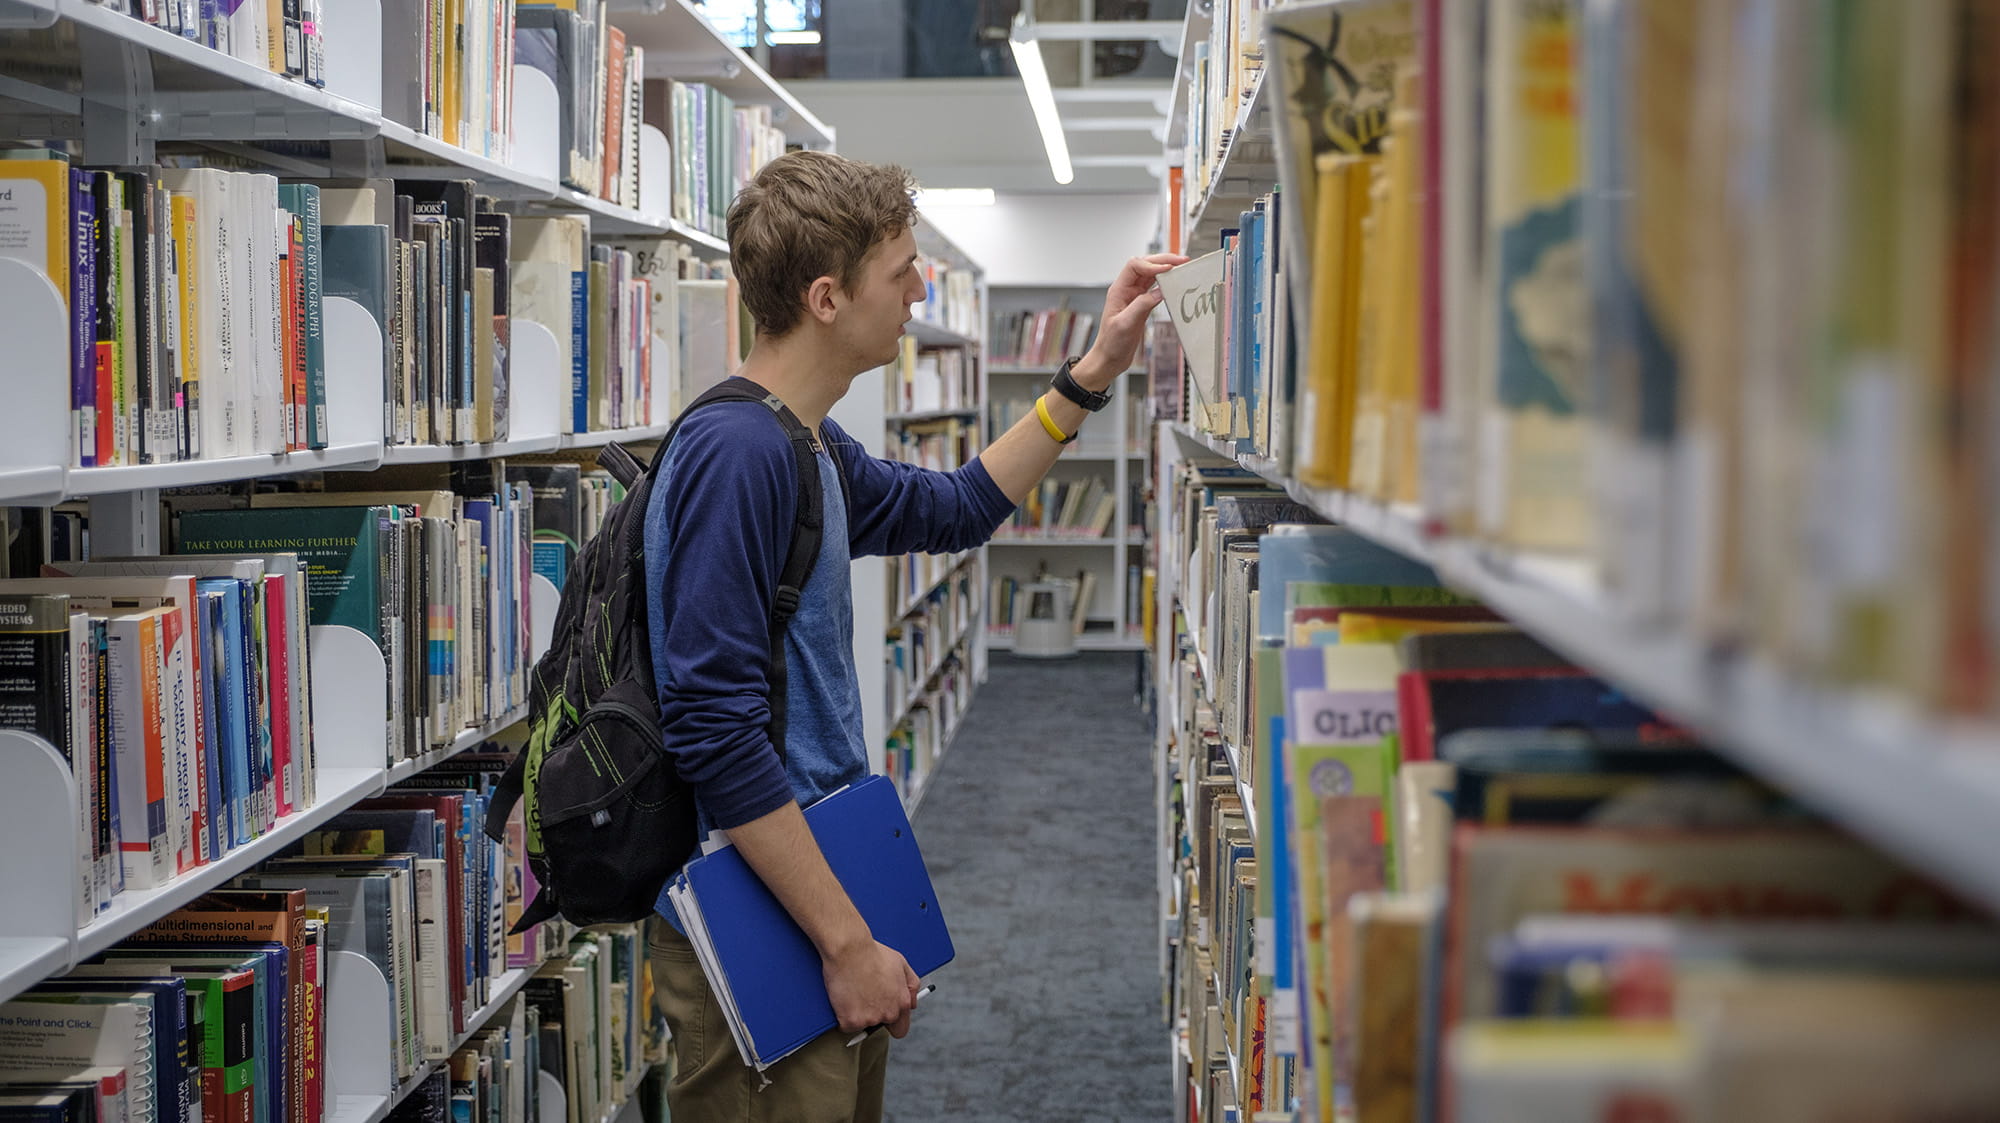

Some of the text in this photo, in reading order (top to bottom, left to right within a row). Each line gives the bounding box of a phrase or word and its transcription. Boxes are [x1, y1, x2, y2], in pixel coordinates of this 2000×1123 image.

[77, 210, 90, 268] Linux
[306, 193, 318, 242] APPLIED
[415, 203, 442, 214] BOOKS
[89, 296, 96, 306] to
[307, 245, 320, 341] CRYPTOGRAPHY
[394, 247, 403, 364] FRACTAL GRAPHICS
[79, 316, 87, 369] Programming
[185, 536, 358, 551] TAKE YOUR LEARNING FURTHER
[63, 652, 73, 758] Computer Security
[80, 641, 88, 709] CODES
[147, 643, 159, 735] Linux Firewalls
[156, 643, 165, 703] Secrets
[172, 683, 185, 810] MANAGEMENT
[175, 649, 191, 822] IT SECURITY PROJECT
[195, 668, 208, 827] Security Strategy
[147, 918, 273, 932] Multidimensional and
[148, 932, 178, 944] Data
[181, 932, 249, 944] Structures
[385, 906, 395, 984] TIM FLANNERY
[16, 1017, 41, 1028] Point
[43, 1019, 65, 1028] and
[305, 982, 315, 1062] ADO.NET
[398, 941, 409, 1050] GLOBAL CLIMATE CHANG
[306, 1067, 315, 1081] 2
